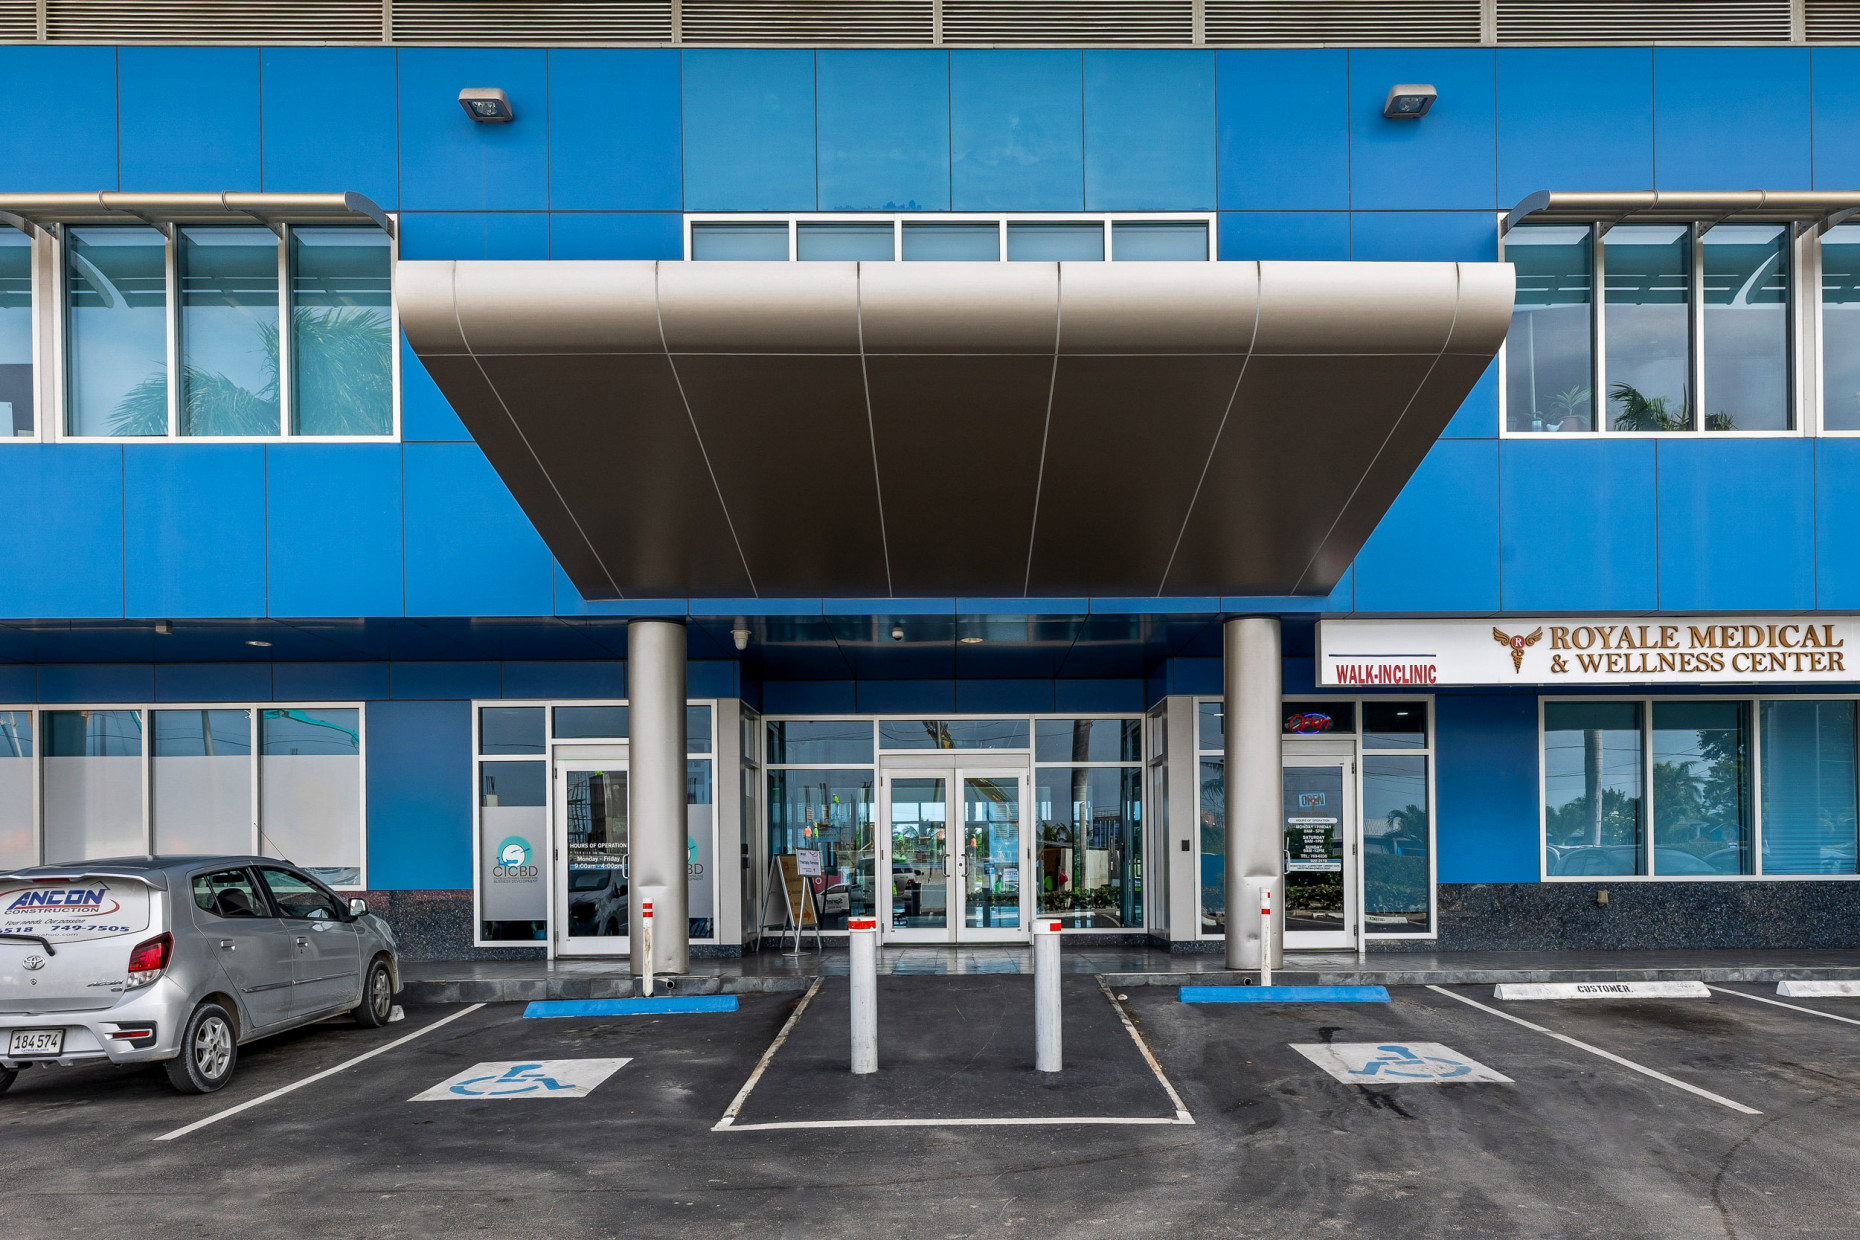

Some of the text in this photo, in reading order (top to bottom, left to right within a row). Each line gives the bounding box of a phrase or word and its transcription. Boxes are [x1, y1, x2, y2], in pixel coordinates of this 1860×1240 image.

[1514, 638, 1522, 647] R
[1550, 624, 1844, 650] ROYALE MEDICAL
[1551, 651, 1846, 673] & WELLNESS CENTER
[1288, 714, 1330, 731] Open
[492, 865, 539, 877] CICBD
[7, 888, 107, 910] ANCON
[4, 907, 100, 915] CONSTRUCTION
[14, 1033, 58, 1049] 184 574
